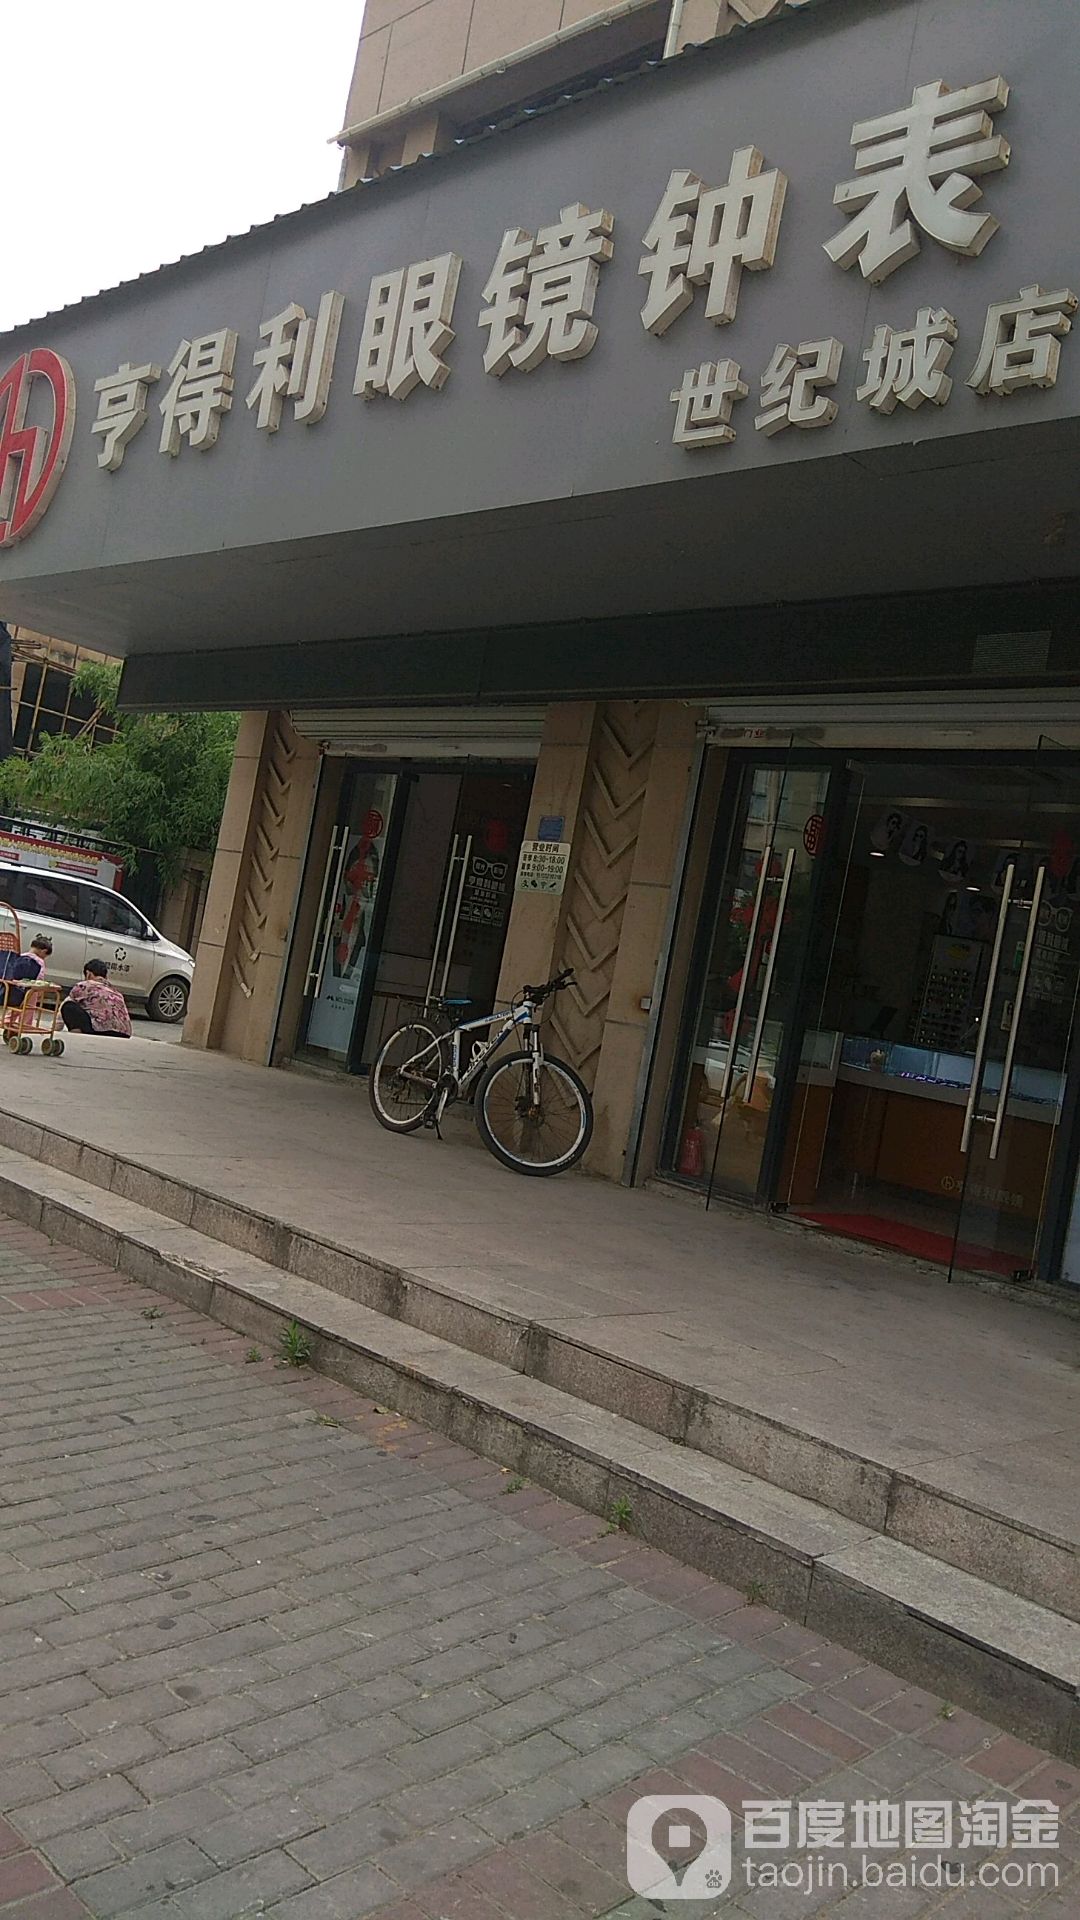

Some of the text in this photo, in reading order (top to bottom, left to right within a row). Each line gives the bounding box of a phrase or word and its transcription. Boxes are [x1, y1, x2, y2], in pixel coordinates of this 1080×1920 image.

[91, 74, 1011, 473] 亨得利眼镜钟表
[671, 283, 1078, 450] 世纪城店
